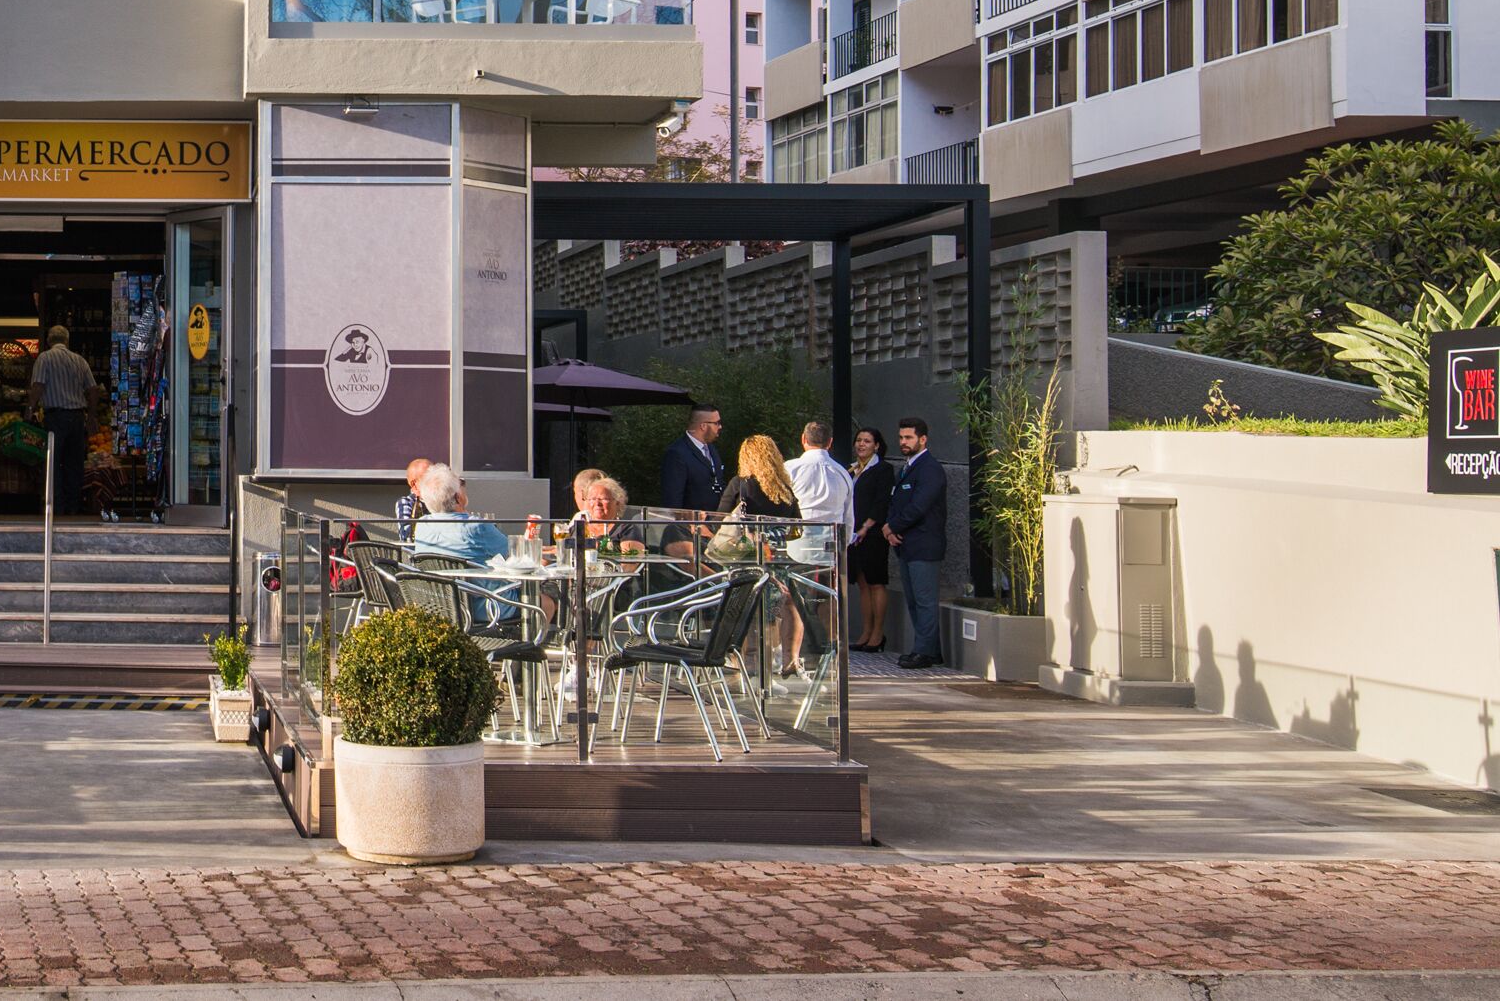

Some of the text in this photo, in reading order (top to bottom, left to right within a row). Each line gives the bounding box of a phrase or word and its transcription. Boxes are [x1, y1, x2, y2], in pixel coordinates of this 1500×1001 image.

[336, 384, 380, 392] ANTONIO
[1464, 369, 1495, 389] WINE
[1464, 389, 1495, 421] BAR
